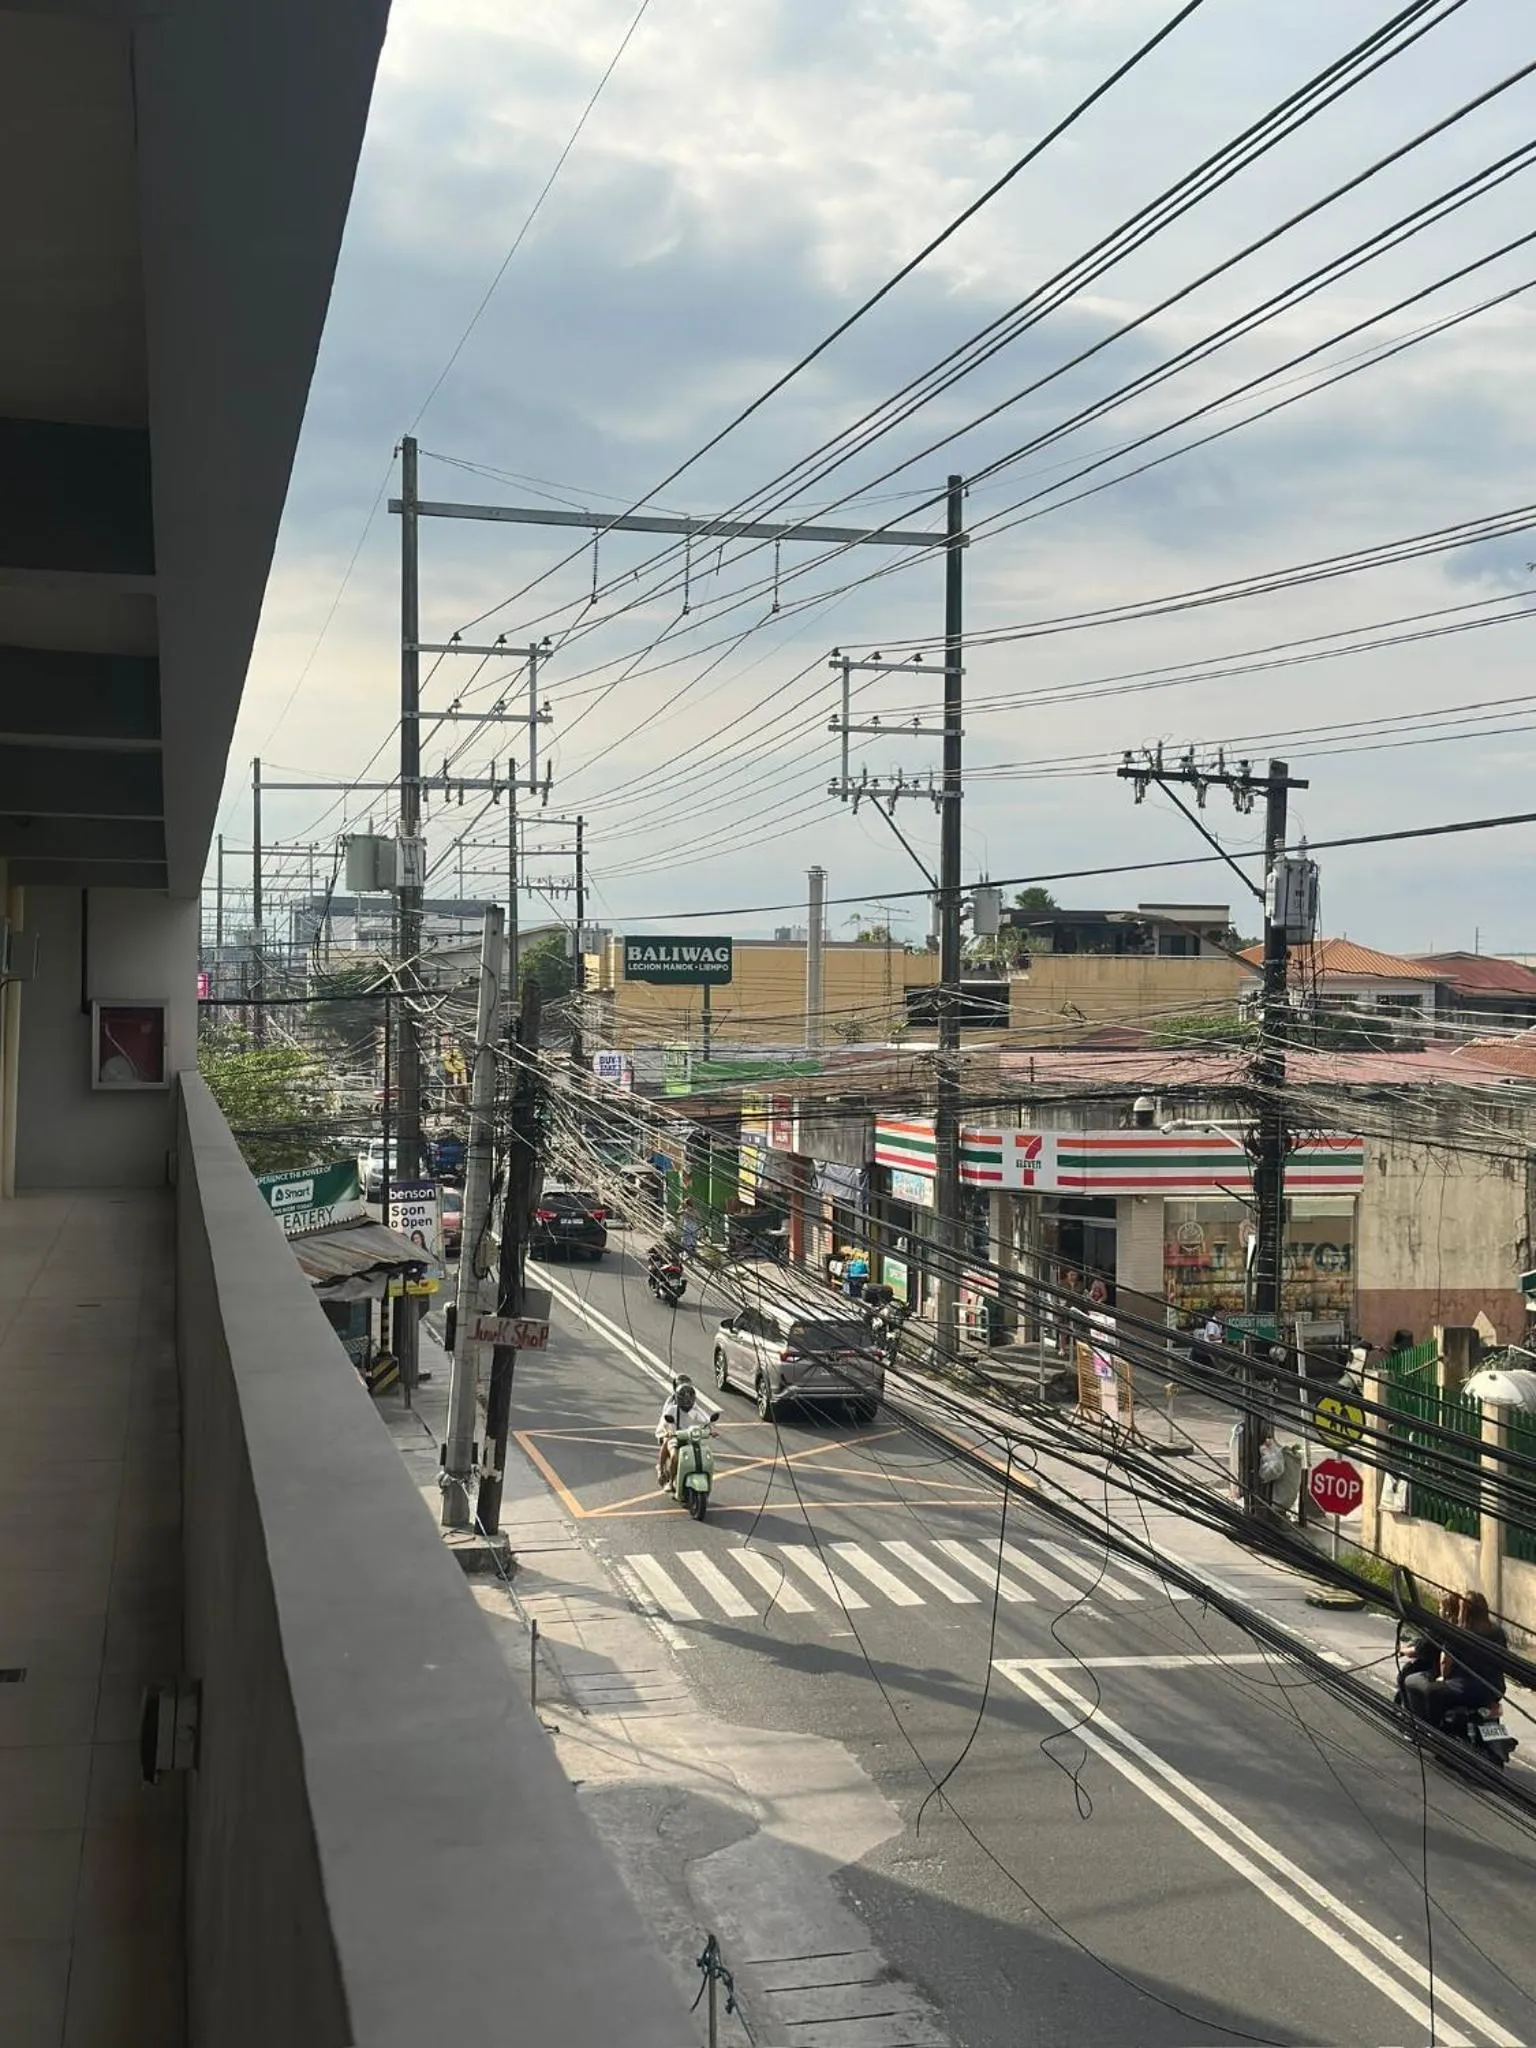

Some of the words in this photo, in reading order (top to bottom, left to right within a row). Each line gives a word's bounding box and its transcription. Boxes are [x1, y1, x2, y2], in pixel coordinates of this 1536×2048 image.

[627, 945, 730, 962] BALIWAG
[628, 963, 661, 971] LECHON
[663, 963, 693, 971] MANOK
[699, 963, 729, 972] LIEMPO
[284, 1186, 310, 1199] Smart
[284, 1204, 335, 1230] EATERY
[391, 1205, 426, 1217] Soon
[401, 1217, 433, 1229] Open
[1313, 1472, 1361, 1501] STOP
